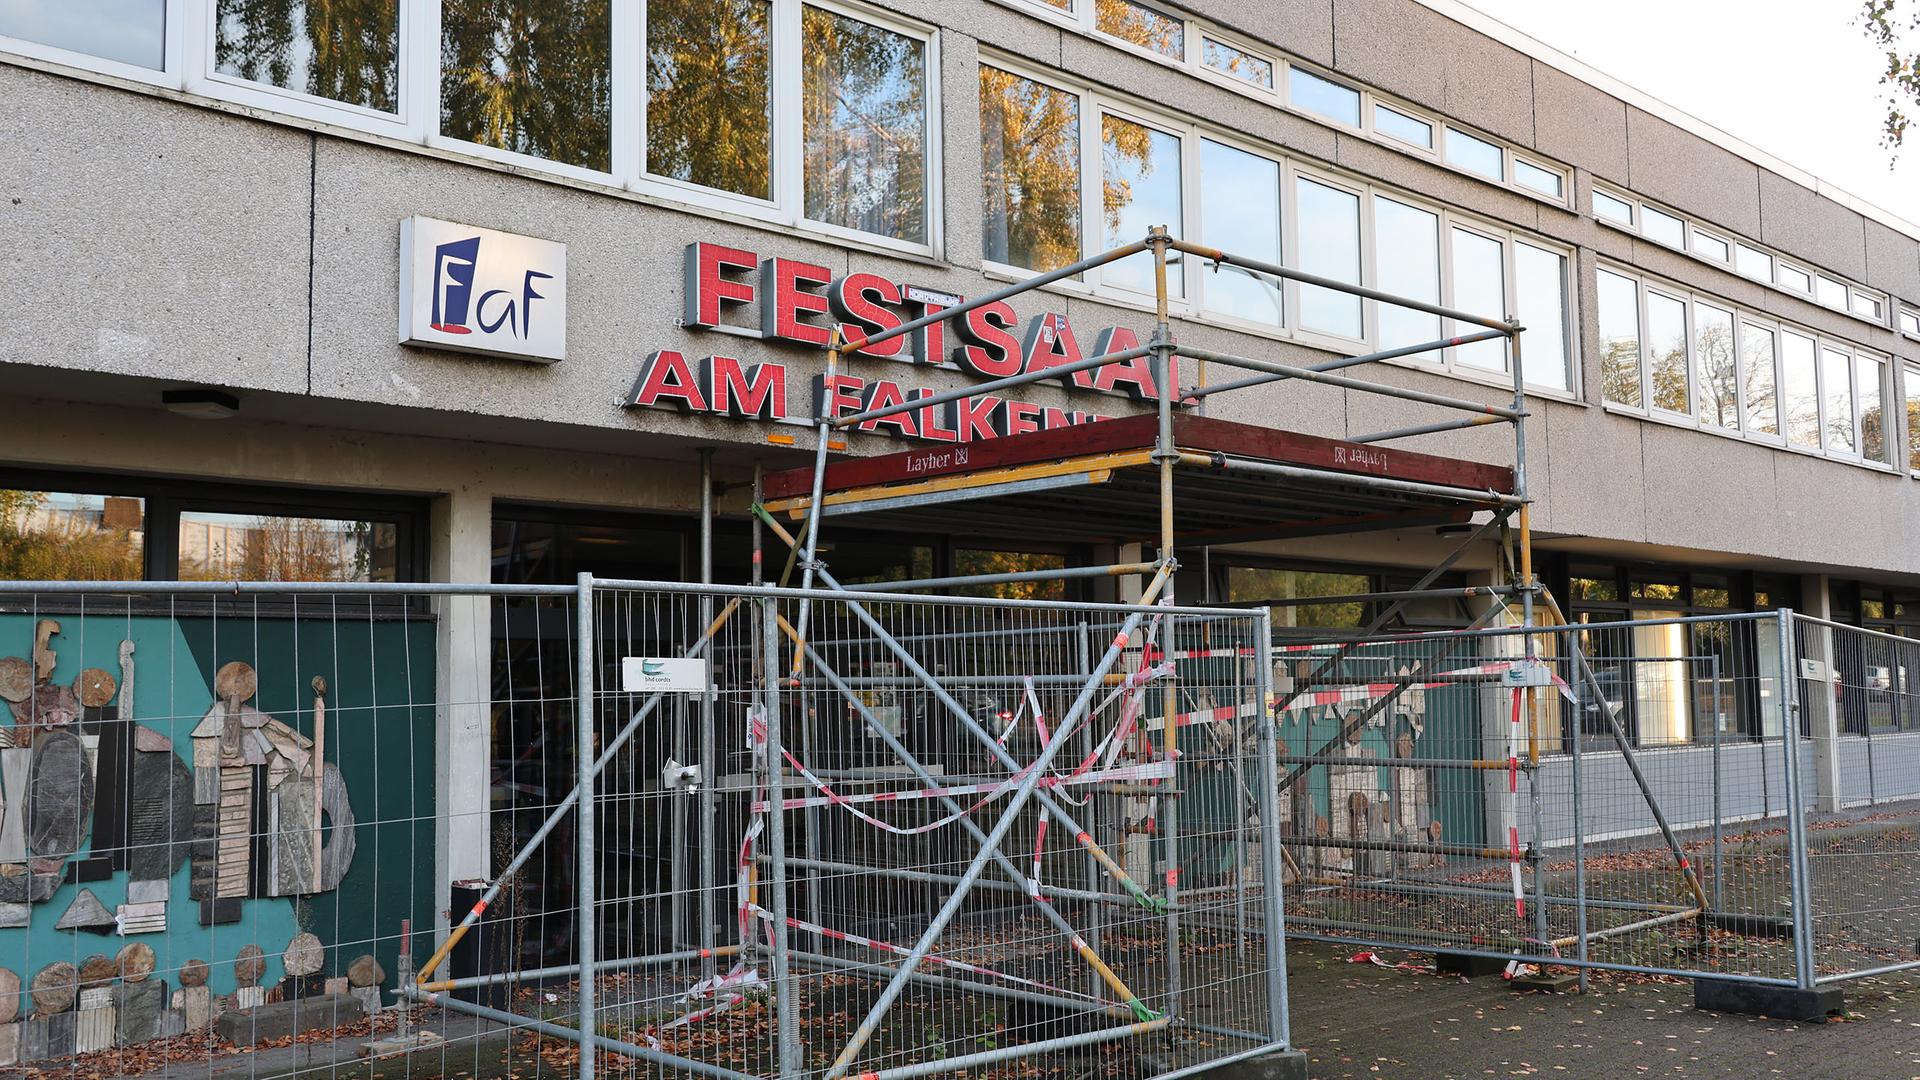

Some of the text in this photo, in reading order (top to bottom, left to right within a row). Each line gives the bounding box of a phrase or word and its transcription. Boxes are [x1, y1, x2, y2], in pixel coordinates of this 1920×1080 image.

[690, 241, 1199, 405] FESTSAAL
[630, 350, 1117, 443] AM FALKE
[906, 452, 951, 474] Layher
[1349, 448, 1388, 471] Layher
